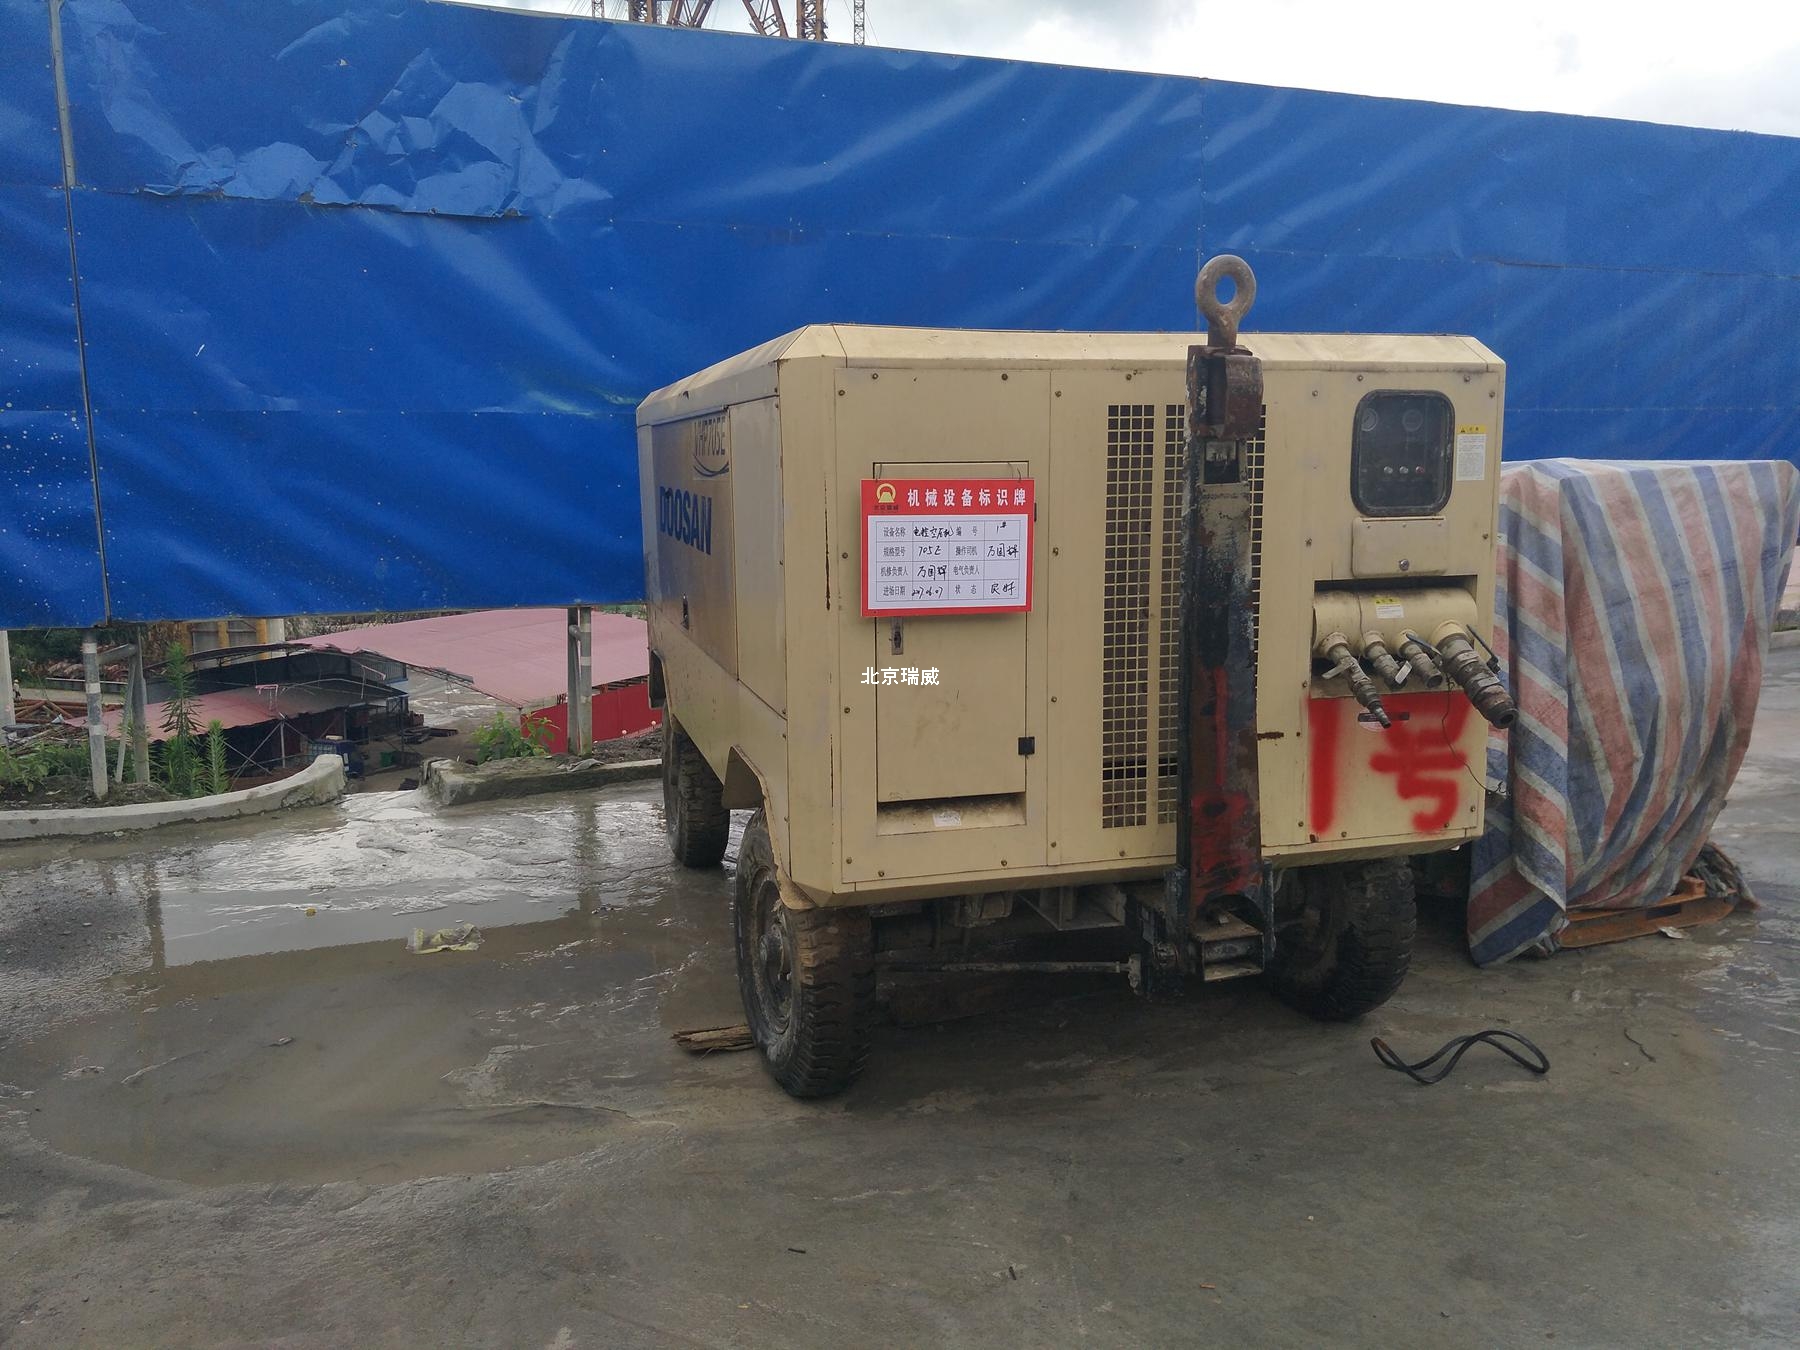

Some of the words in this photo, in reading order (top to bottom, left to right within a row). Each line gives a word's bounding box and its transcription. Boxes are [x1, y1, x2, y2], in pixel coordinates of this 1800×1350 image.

[907, 488, 1027, 507] 机械设备标识牌
[659, 486, 713, 555] DOOSAN
[883, 527, 906, 537] 设备名称
[883, 546, 906, 557] 规格型号
[955, 545, 978, 556] 操作司机
[880, 566, 908, 577] 机修负责人
[953, 565, 980, 576] 电气负责人
[883, 585, 906, 596] 进场日期
[990, 581, 1016, 595] 良好
